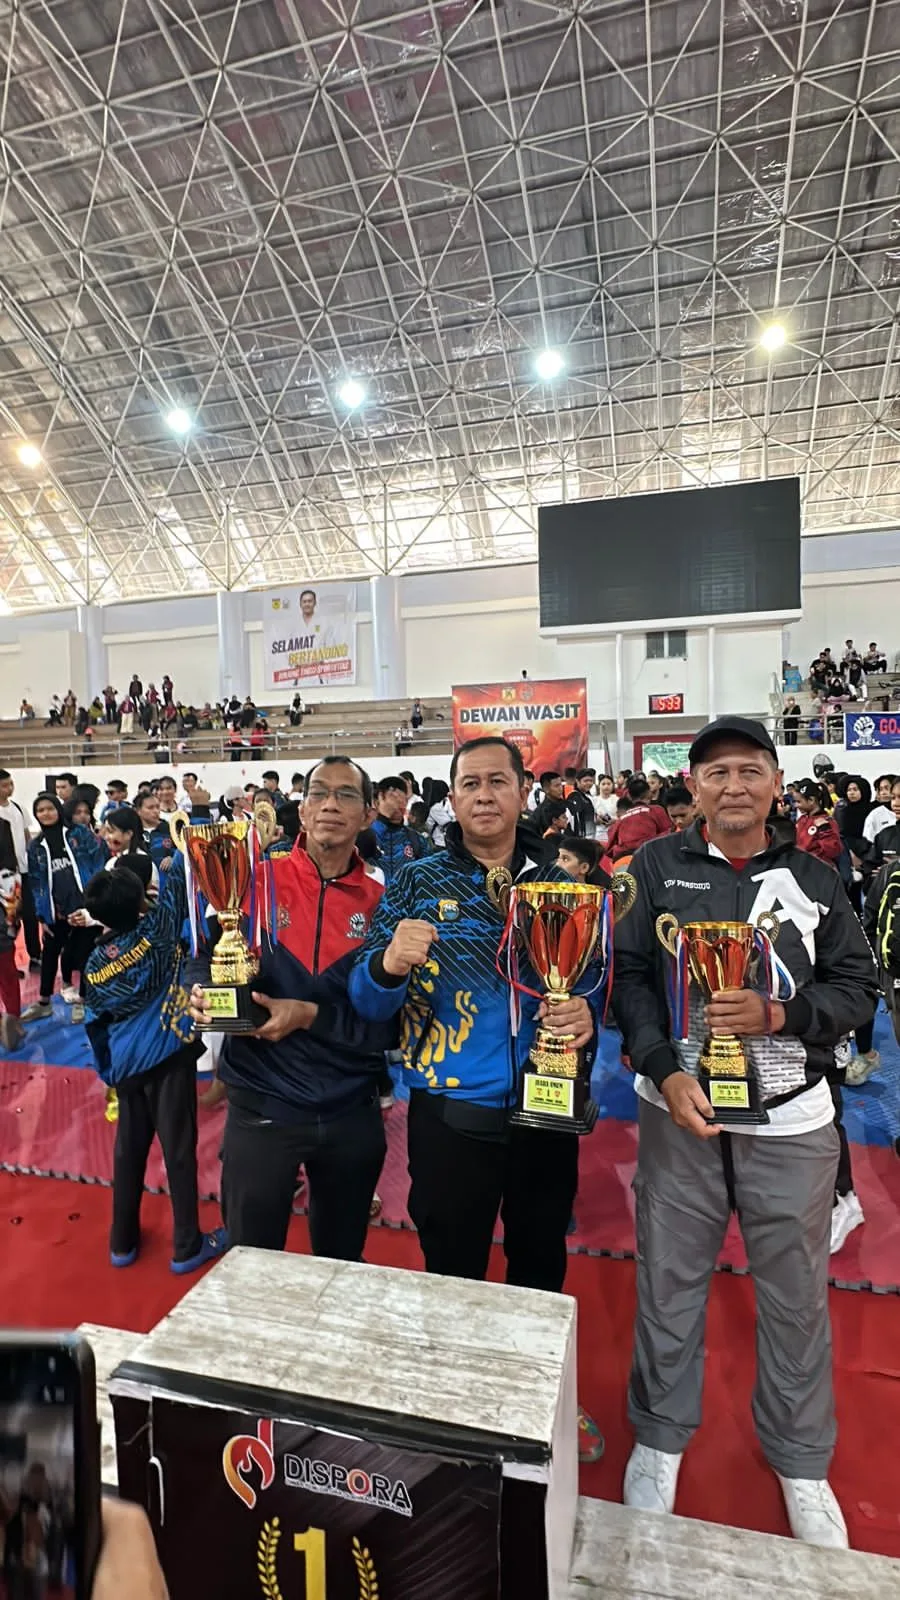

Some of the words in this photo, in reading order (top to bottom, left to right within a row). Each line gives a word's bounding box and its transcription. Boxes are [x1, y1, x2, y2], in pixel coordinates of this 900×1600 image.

[271, 635, 315, 654] SELAMAT
[288, 643, 348, 666] BERTANDING
[460, 706, 520, 723] DEWAN
[523, 703, 581, 721] WASIT
[284, 1453, 413, 1512] DISPORA
[294, 1525, 326, 1600] 1
